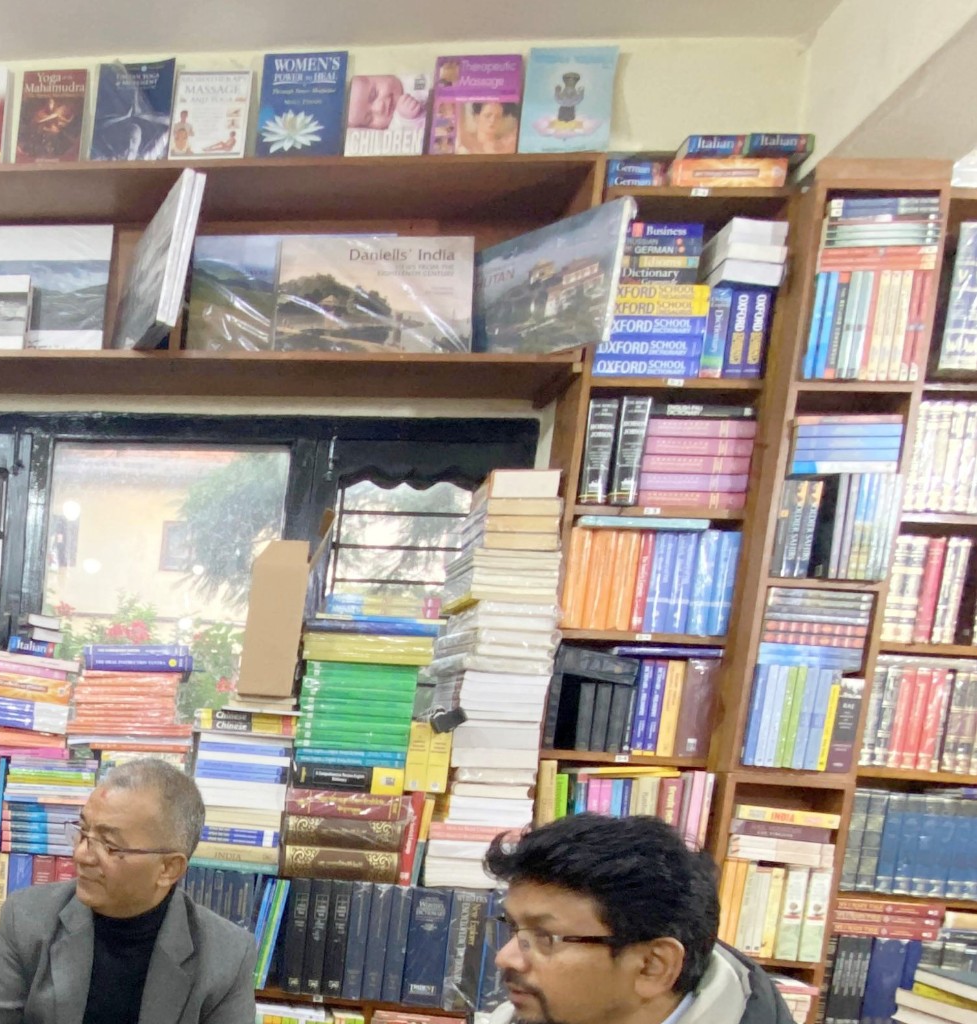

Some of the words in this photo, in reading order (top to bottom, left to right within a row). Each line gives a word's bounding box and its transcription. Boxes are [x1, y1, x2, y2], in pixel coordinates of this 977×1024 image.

[274, 57, 341, 72] WOMEN'S
[461, 60, 516, 74] Therapeutic
[37, 72, 61, 84] Yoga
[273, 73, 303, 82] POWER
[313, 72, 337, 81] HEAL
[459, 76, 505, 89] Massage
[24, 82, 85, 93] Mahamudra
[185, 85, 241, 94] MASSAGE
[350, 129, 424, 155] CHILDREN
[697, 137, 734, 150] Italian
[760, 135, 799, 147] Italian
[616, 162, 651, 174] German
[614, 176, 652, 186] German
[646, 225, 687, 236] Business
[349, 248, 412, 261] Daniells'
[418, 248, 455, 261] India
[634, 246, 674, 254] GERMAN
[622, 268, 679, 280] Dictionary
[616, 287, 657, 298] XFORD
[658, 285, 694, 293] SCHOOL
[613, 303, 655, 314] XFORD
[656, 301, 692, 309] SCHOOL
[734, 294, 749, 332] OXFORD
[752, 294, 767, 332] OXFORD
[612, 319, 653, 333] XFORD
[653, 318, 692, 328] SCHOOL
[650, 340, 688, 350] SCHOOL
[597, 360, 647, 374] OXFORD
[648, 360, 686, 369] SCHOOL
[17, 638, 46, 653] Italian
[216, 711, 247, 721] Chinese
[216, 721, 247, 731] Chinese
[771, 812, 794, 822] INDIA
[215, 852, 241, 861] INDIA
